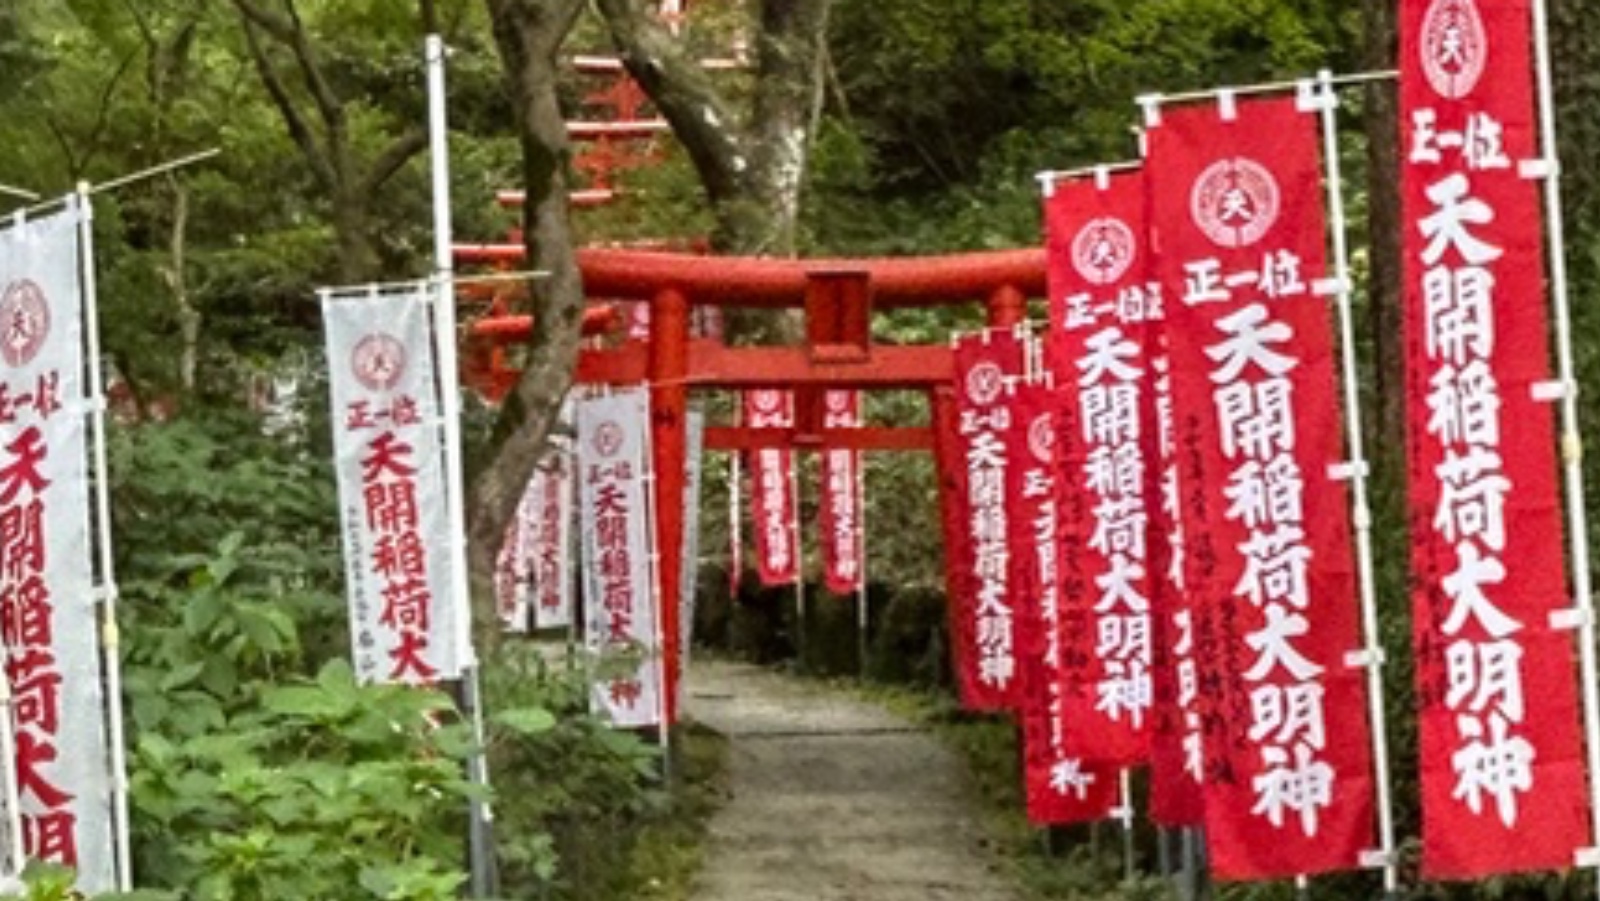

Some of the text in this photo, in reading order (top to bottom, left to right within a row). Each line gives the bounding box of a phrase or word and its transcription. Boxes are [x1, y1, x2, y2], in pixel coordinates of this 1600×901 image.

[1409, 107, 1511, 170] 正一位
[1182, 248, 1306, 306] 正一位
[347, 394, 423, 431] 正一位
[1076, 326, 1153, 730] 天開稲荷大明神
[1417, 172, 1535, 829] 天開稲荷大明神
[1204, 302, 1336, 837] 天開稲荷大明神
